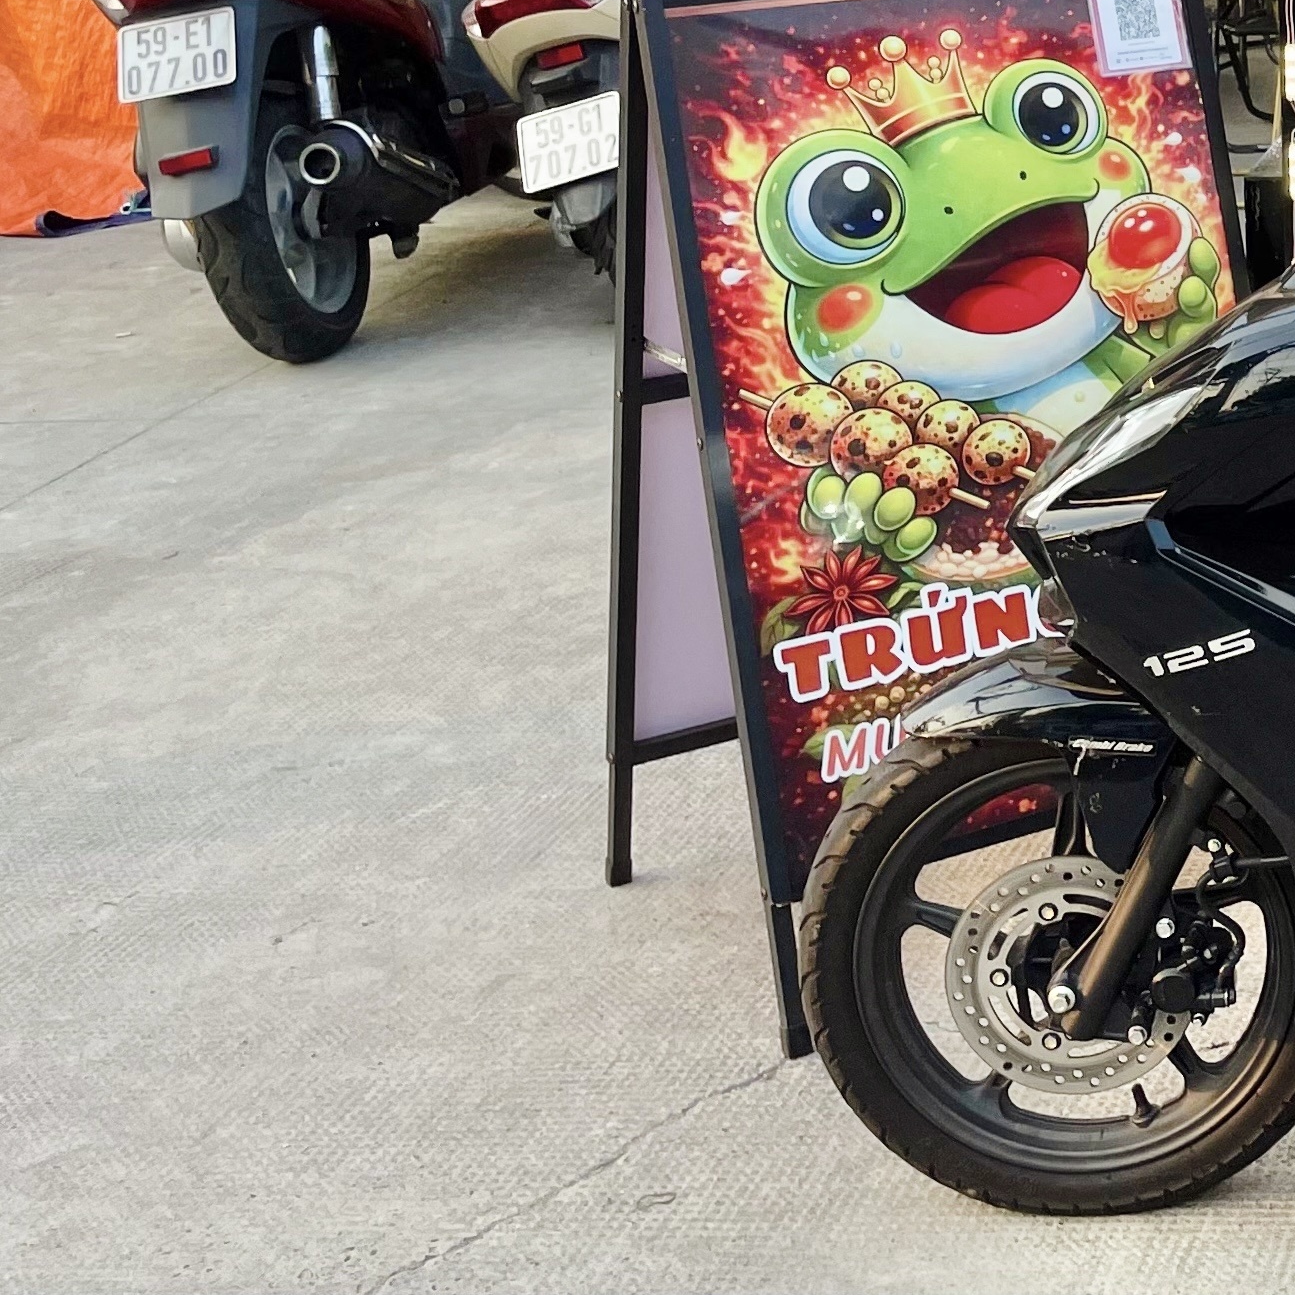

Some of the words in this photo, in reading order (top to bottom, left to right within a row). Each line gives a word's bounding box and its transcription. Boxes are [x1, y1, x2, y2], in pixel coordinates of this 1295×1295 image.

[136, 15, 212, 59] 59-E1
[127, 48, 228, 96] 077.00
[535, 103, 603, 149] 59-G1
[529, 133, 619, 185] 707.02
[778, 587, 1062, 696] TRỨN
[1142, 628, 1256, 677] 125
